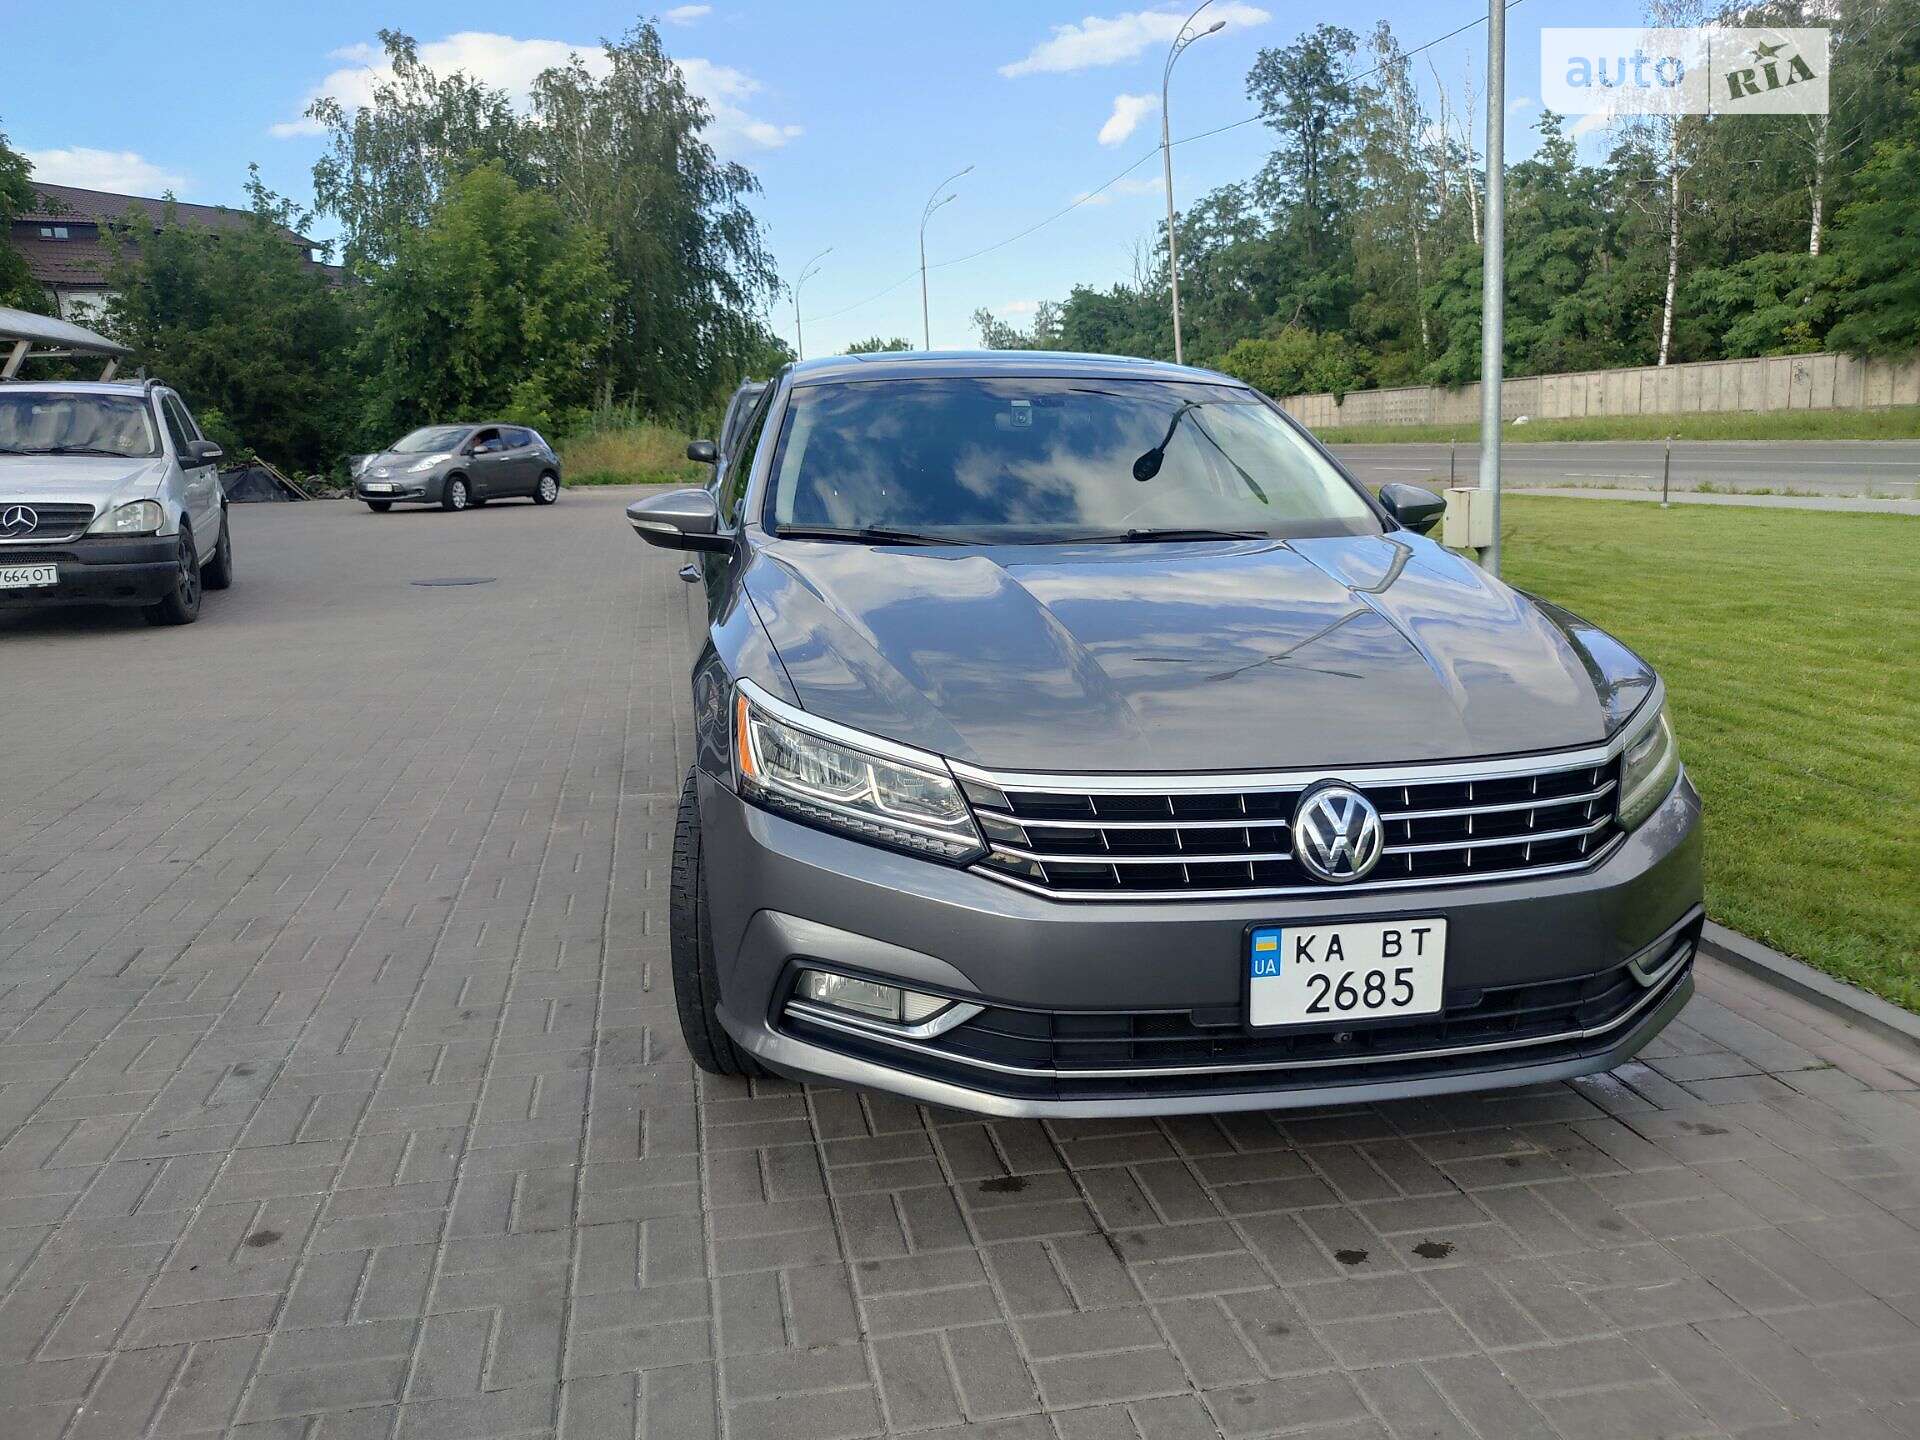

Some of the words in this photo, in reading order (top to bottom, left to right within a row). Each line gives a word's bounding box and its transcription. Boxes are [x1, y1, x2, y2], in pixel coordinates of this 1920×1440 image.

[33, 568, 54, 581] OT
[1382, 928, 1431, 958] BT
[1254, 958, 1276, 975] UA
[1305, 967, 1414, 1014] 2685
